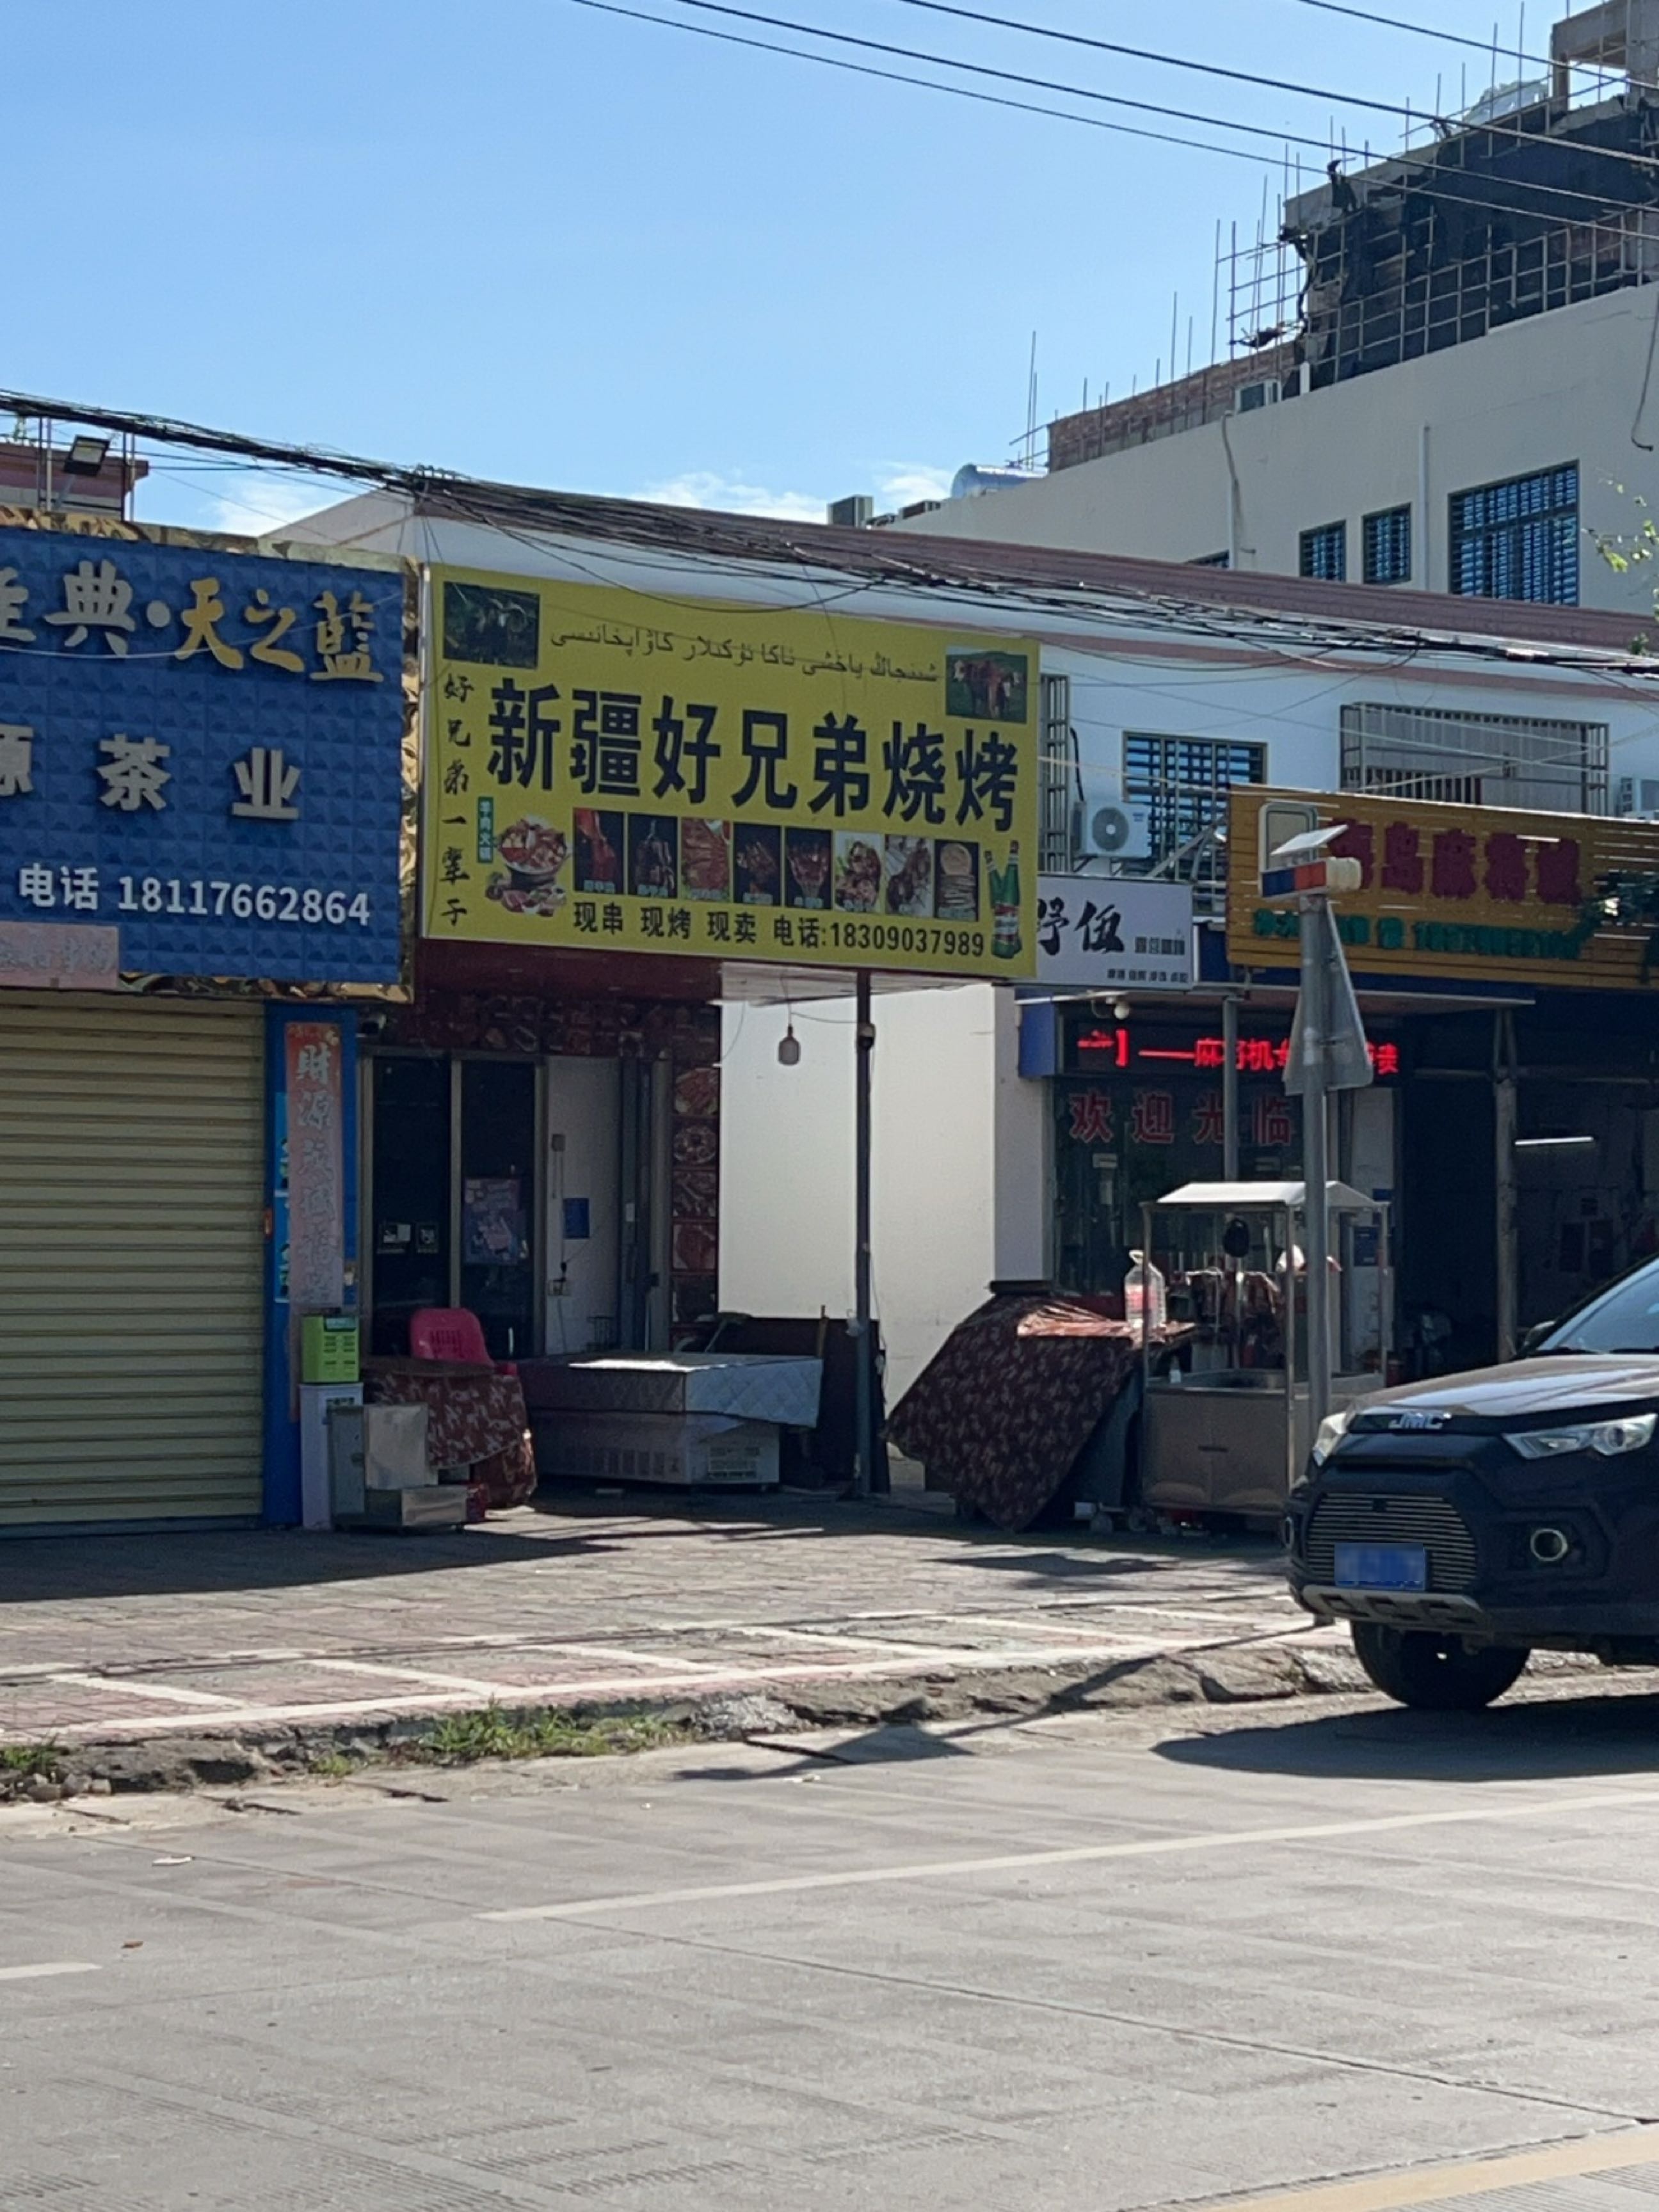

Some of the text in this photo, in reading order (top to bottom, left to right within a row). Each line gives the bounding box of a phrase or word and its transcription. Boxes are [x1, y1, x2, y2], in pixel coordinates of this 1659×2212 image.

[486, 678, 1020, 832] 新疆好兄弟烧烤
[19, 863, 371, 926] 电话 18117662864
[573, 901, 624, 935] 现串
[640, 906, 691, 940] 现烤
[706, 911, 757, 944] 现卖
[1070, 1089, 1292, 1147] 欢迎光临
[1388, 1411, 1452, 1431] JMC
